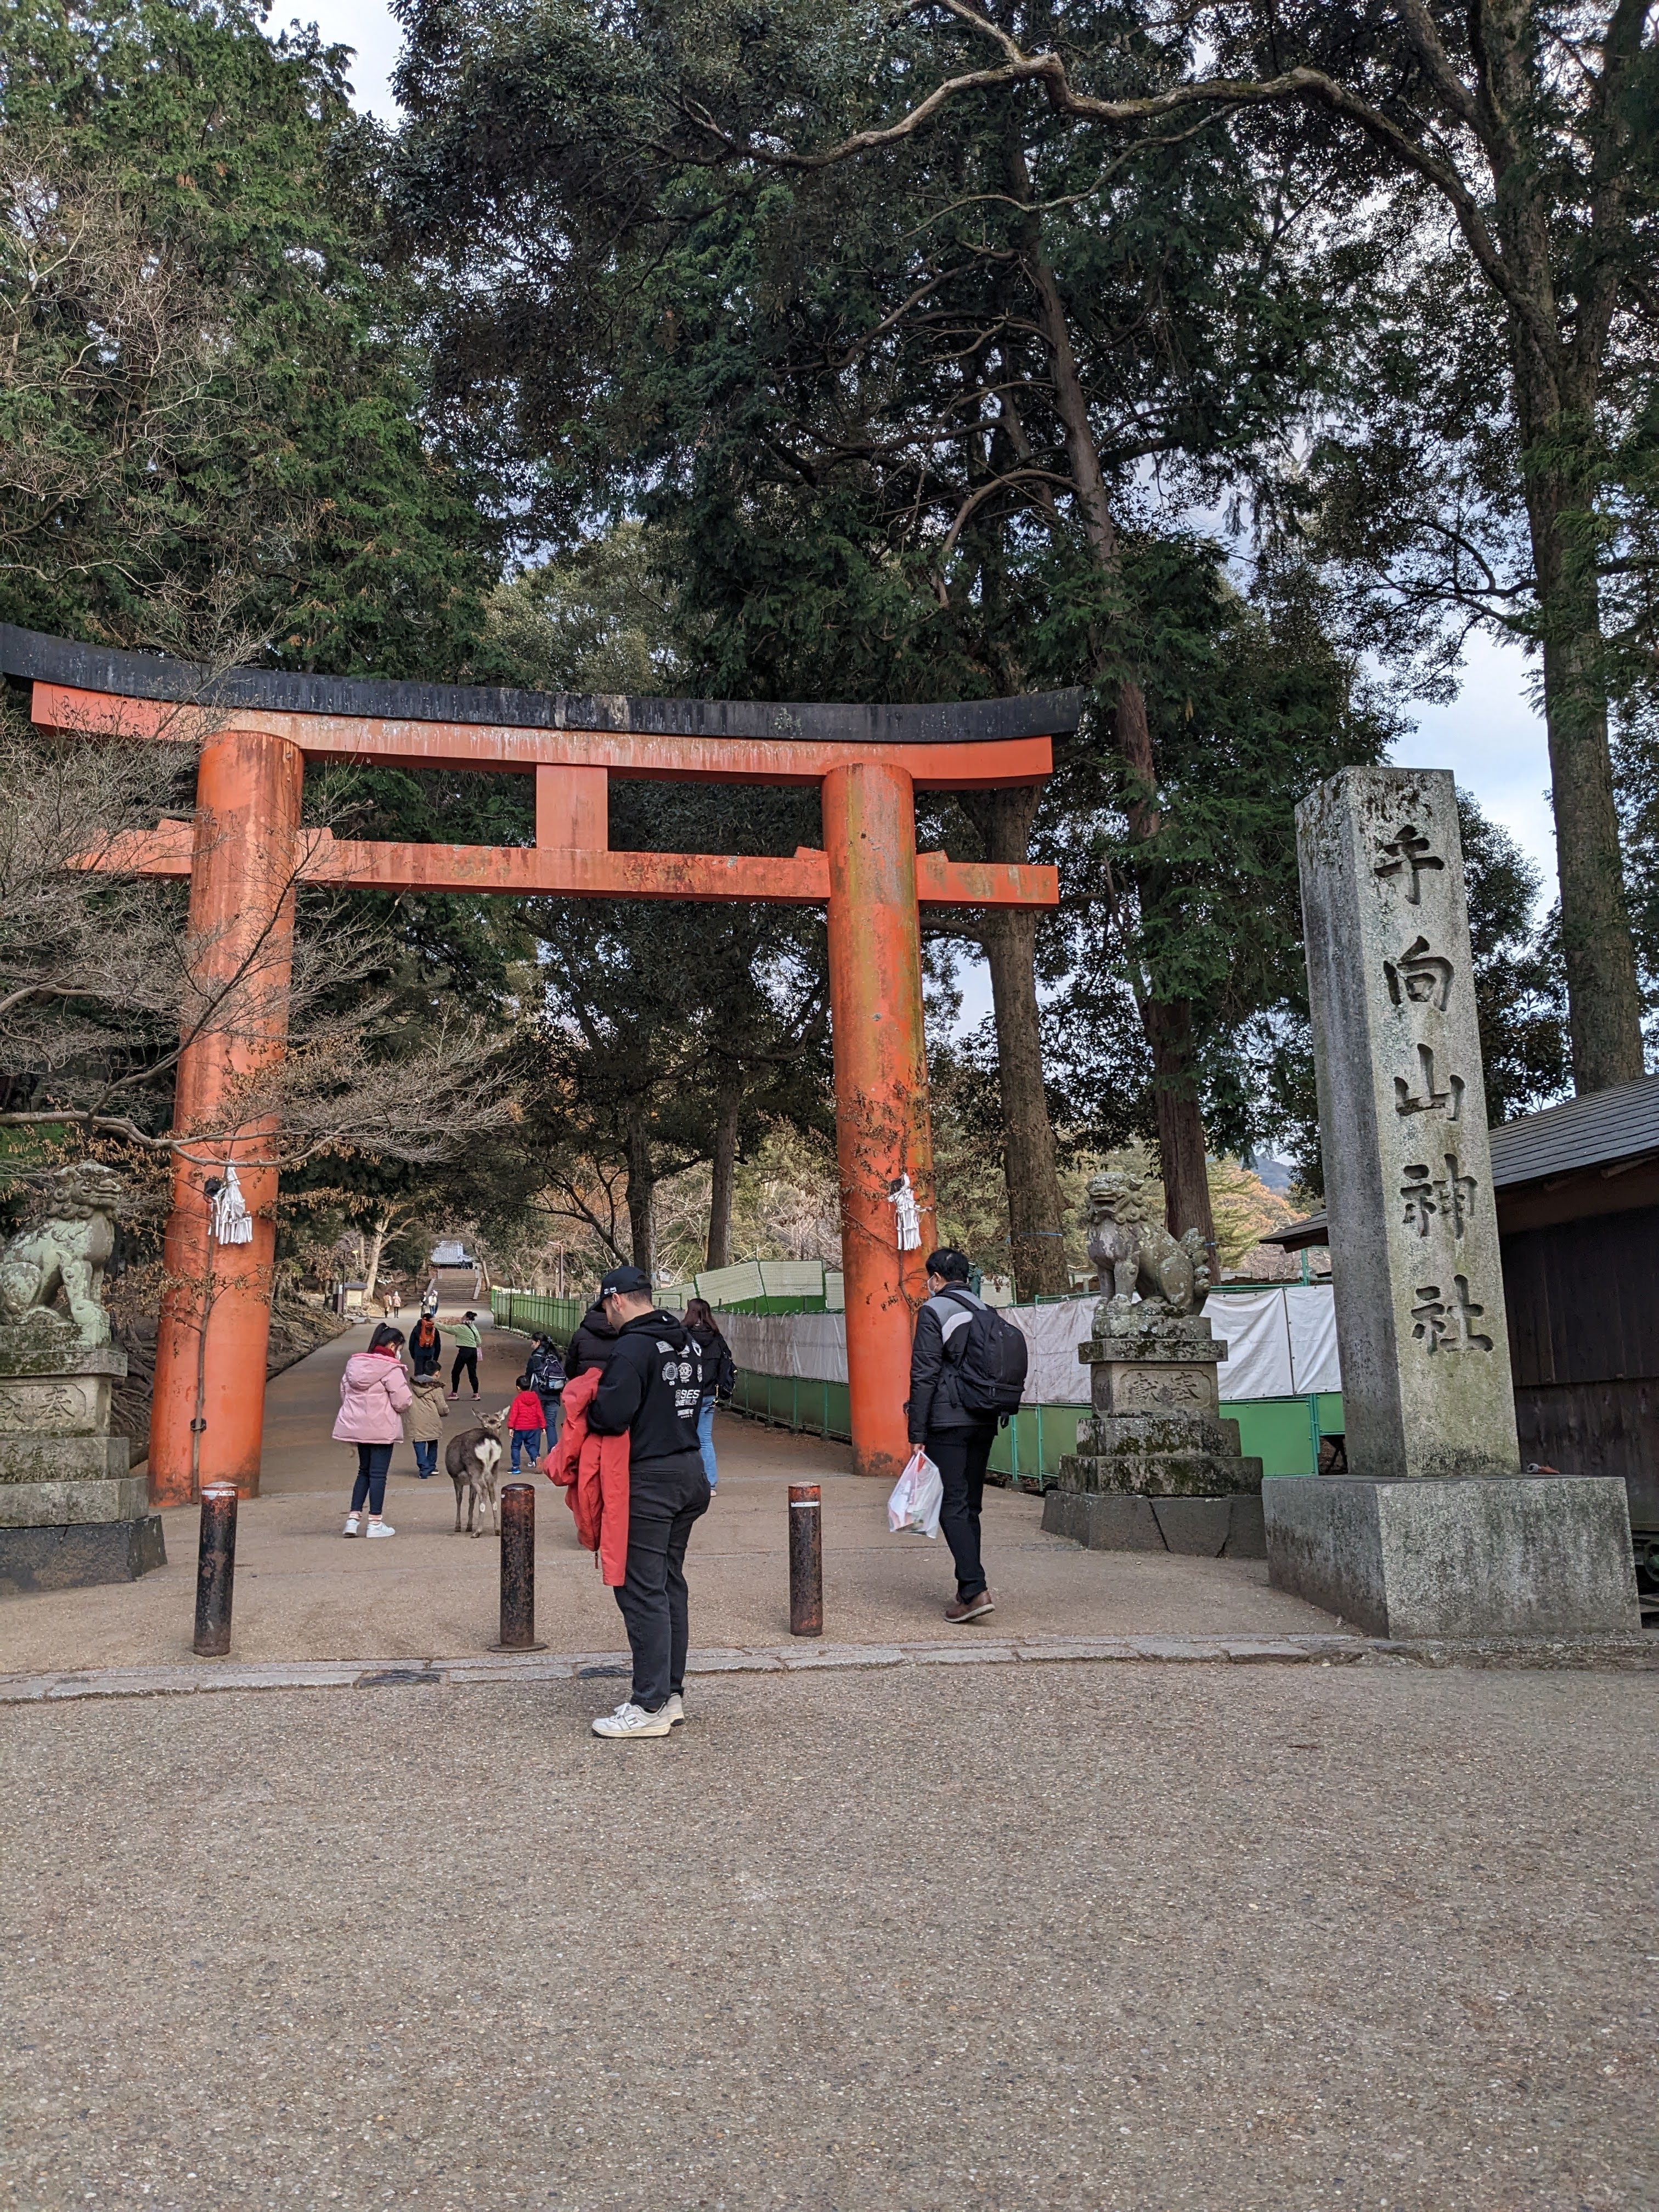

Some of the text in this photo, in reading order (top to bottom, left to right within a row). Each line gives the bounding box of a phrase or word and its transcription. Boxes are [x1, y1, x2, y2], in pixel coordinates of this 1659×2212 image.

[1374, 824, 1493, 1356] 手向山神社
